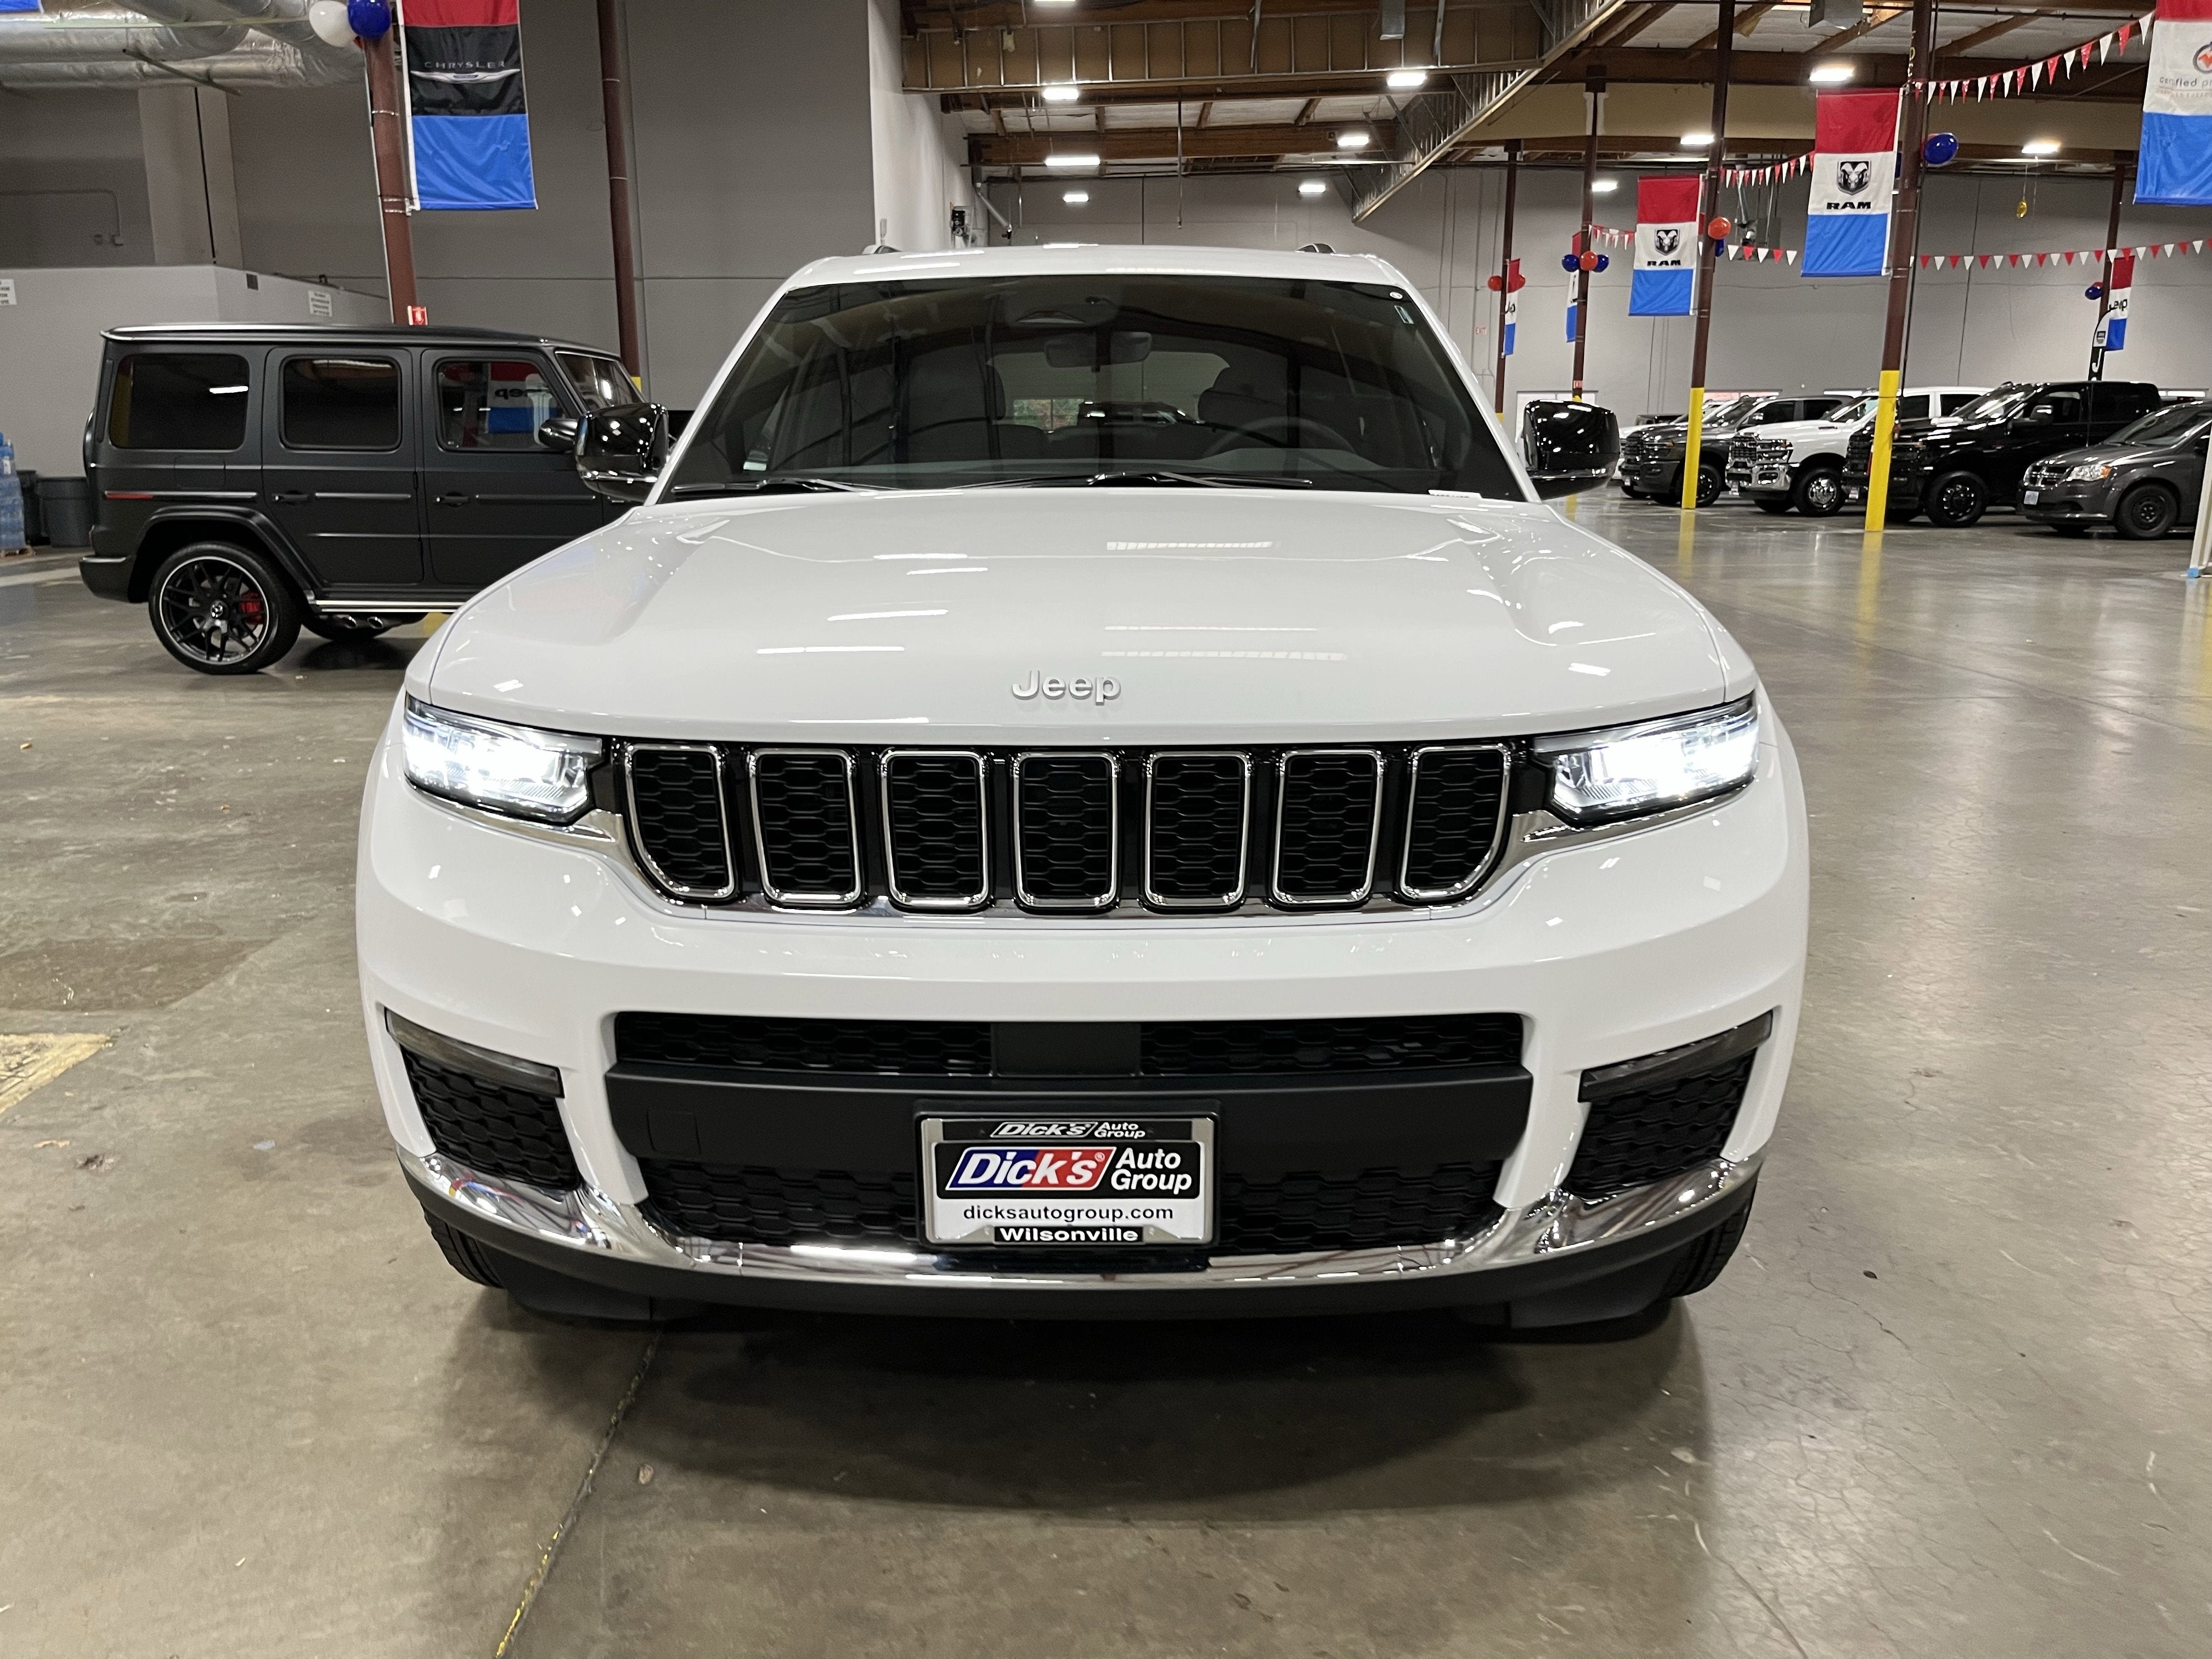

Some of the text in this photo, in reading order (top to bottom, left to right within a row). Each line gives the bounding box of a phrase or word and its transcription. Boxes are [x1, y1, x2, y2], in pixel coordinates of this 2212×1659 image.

[424, 60, 505, 69] CHRYSLER
[1826, 201, 1871, 210] RAM
[1012, 670, 1121, 706] Jeep
[998, 1123, 1087, 1135] Dick's
[1097, 1122, 1139, 1130] Auto
[1094, 1129, 1146, 1139] Group
[1115, 1147, 1181, 1169] Auto
[958, 1152, 1098, 1185] Dick's
[1110, 1169, 1192, 1195] Group
[963, 1205, 1173, 1222] dicksautogroup.com
[1000, 1228, 1138, 1242] Wilsonville
